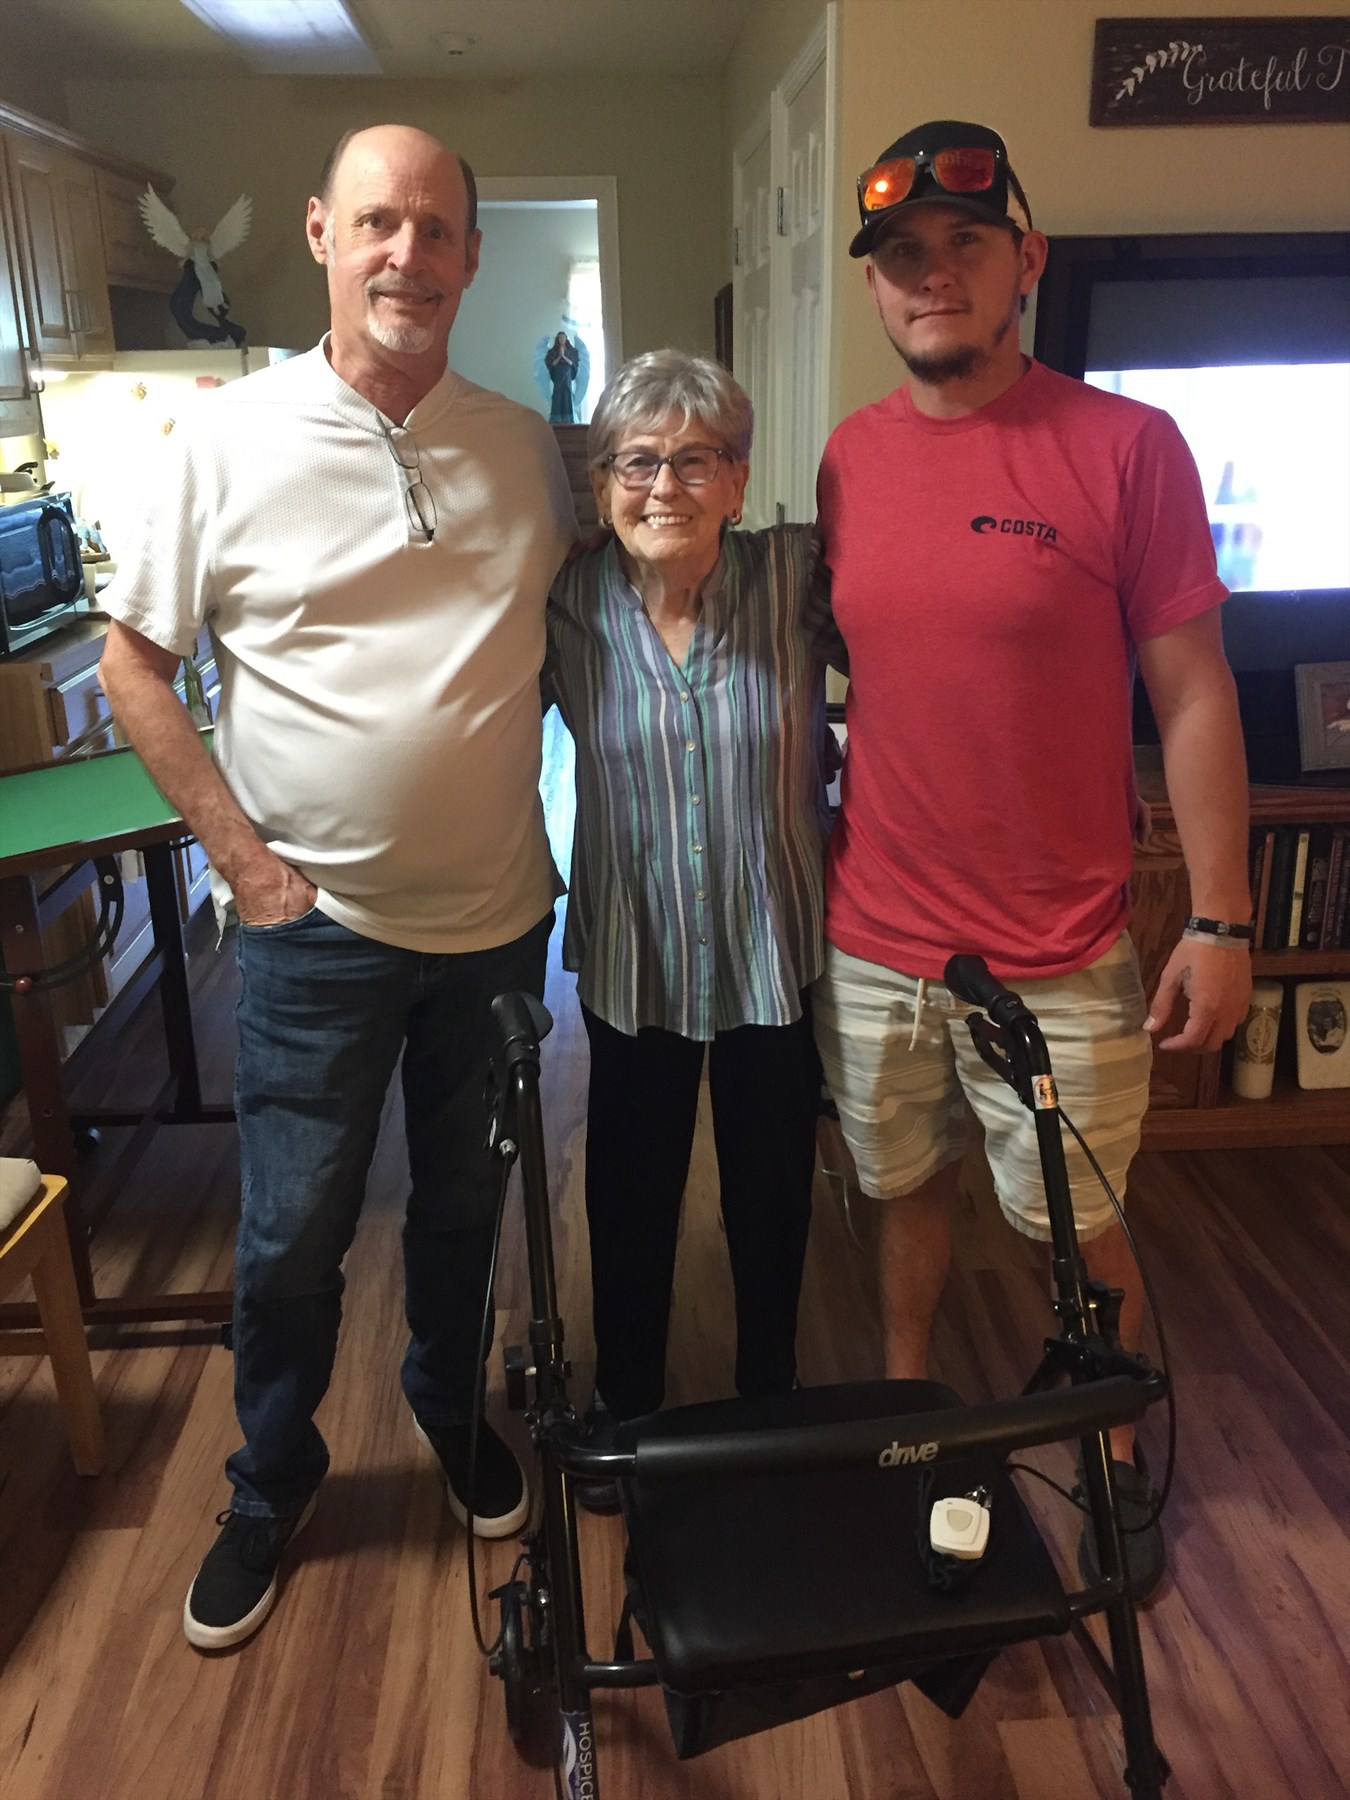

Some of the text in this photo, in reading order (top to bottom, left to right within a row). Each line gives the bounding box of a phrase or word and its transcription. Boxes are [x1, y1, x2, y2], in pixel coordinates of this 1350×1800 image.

[1182, 47, 1311, 111] Grateful
[1000, 518, 1057, 543] COSTA
[879, 1441, 939, 1468] drive
